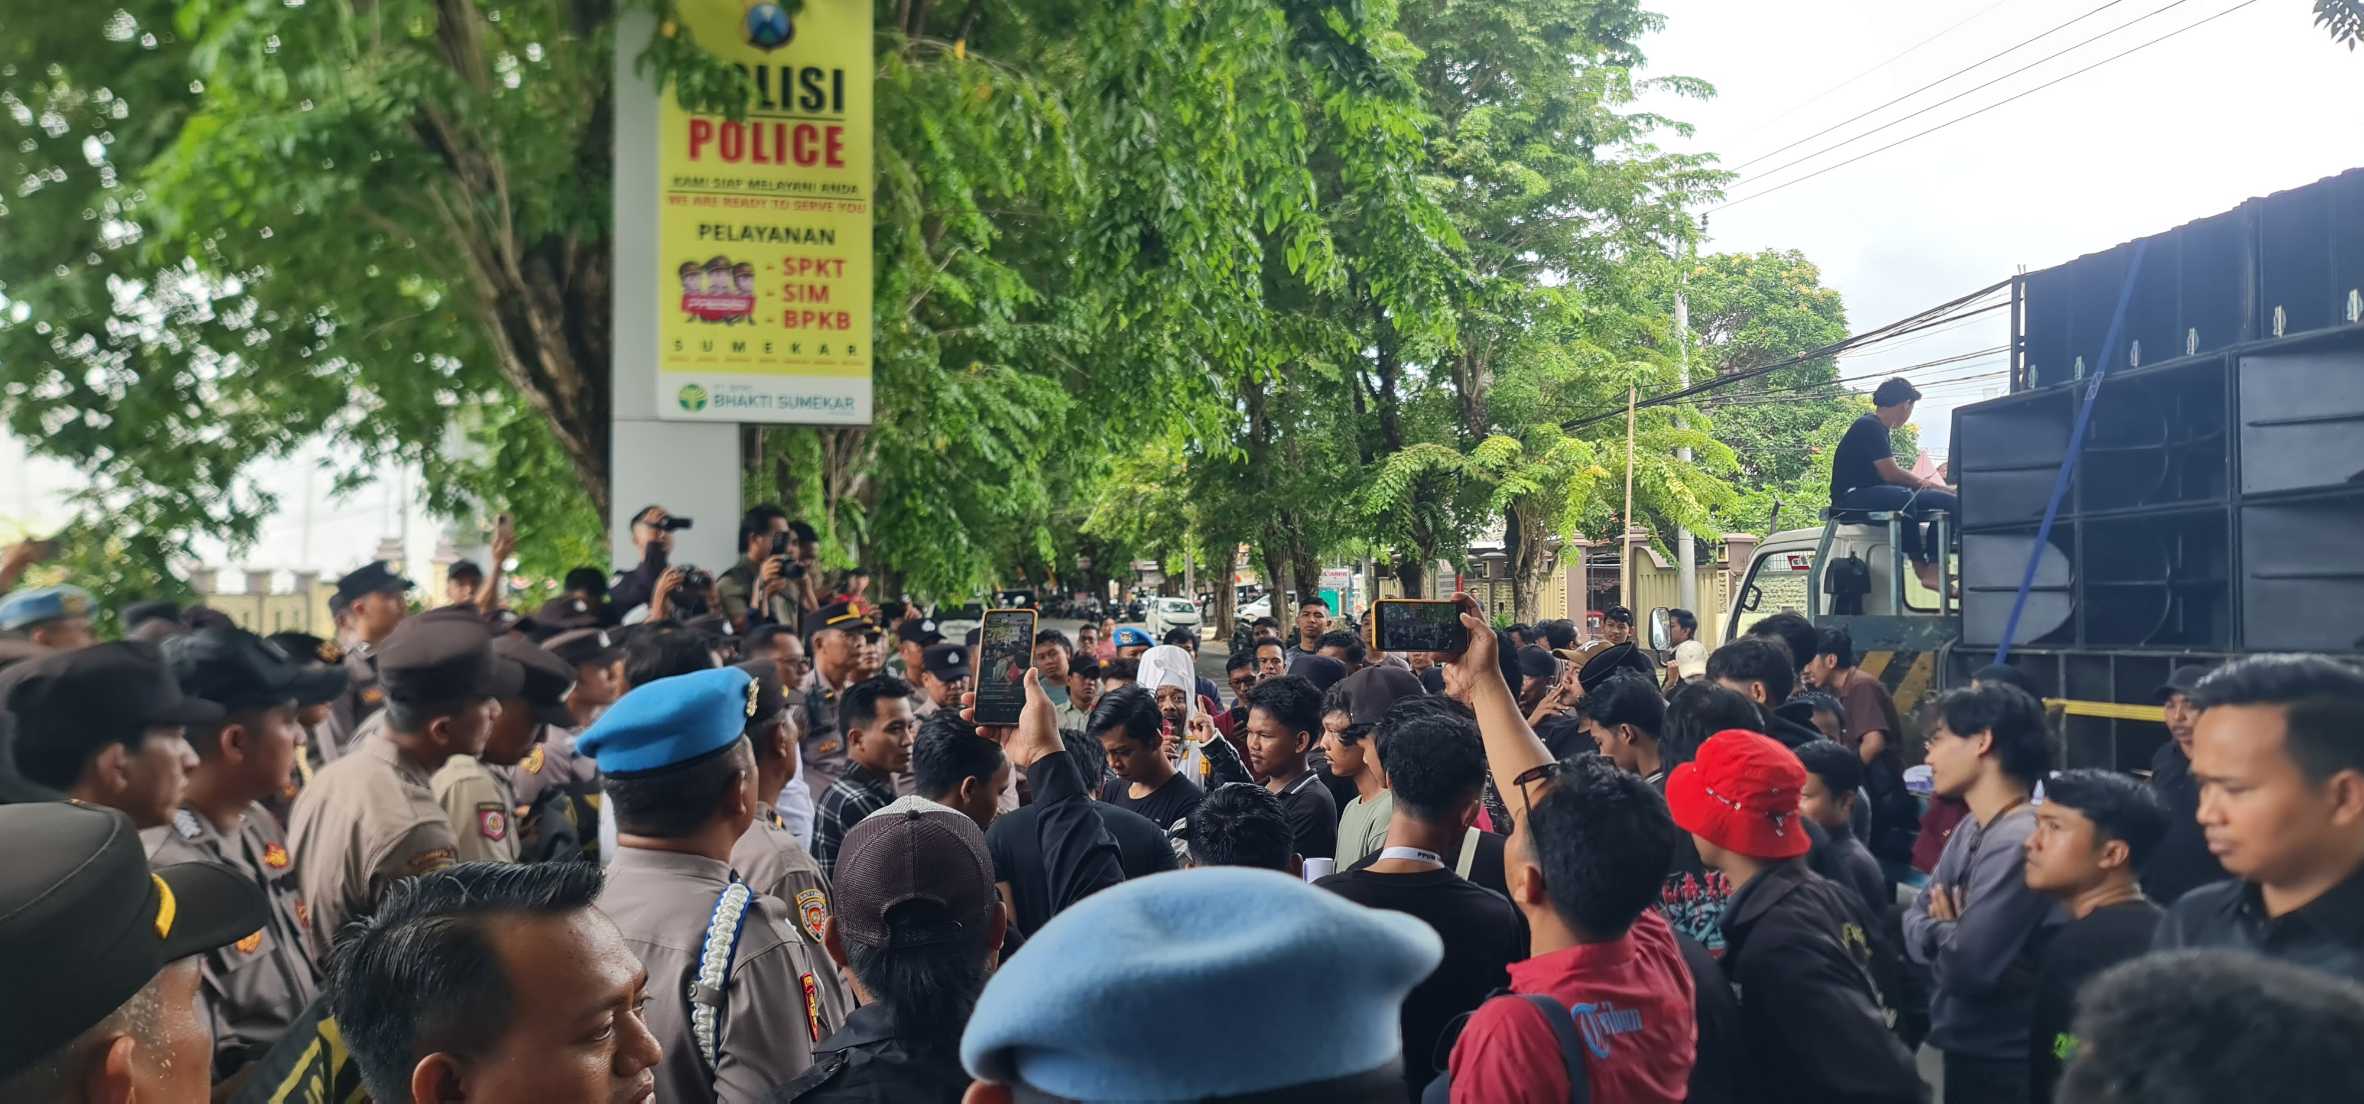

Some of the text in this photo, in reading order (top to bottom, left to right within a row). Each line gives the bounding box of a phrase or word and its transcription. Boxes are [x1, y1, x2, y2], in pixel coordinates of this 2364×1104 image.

[689, 118, 845, 169] POLICE
[673, 176, 858, 195] KAMI SIAP MELAYANI ANDA
[669, 195, 866, 214] WE ARE READY TO SERVE YOU
[698, 224, 835, 246] PELAYANAN
[782, 256, 846, 278] SPKT
[782, 284, 829, 304] SIM
[783, 310, 851, 331] BPKB
[714, 394, 855, 411] BHAKTI SUMEKAR
